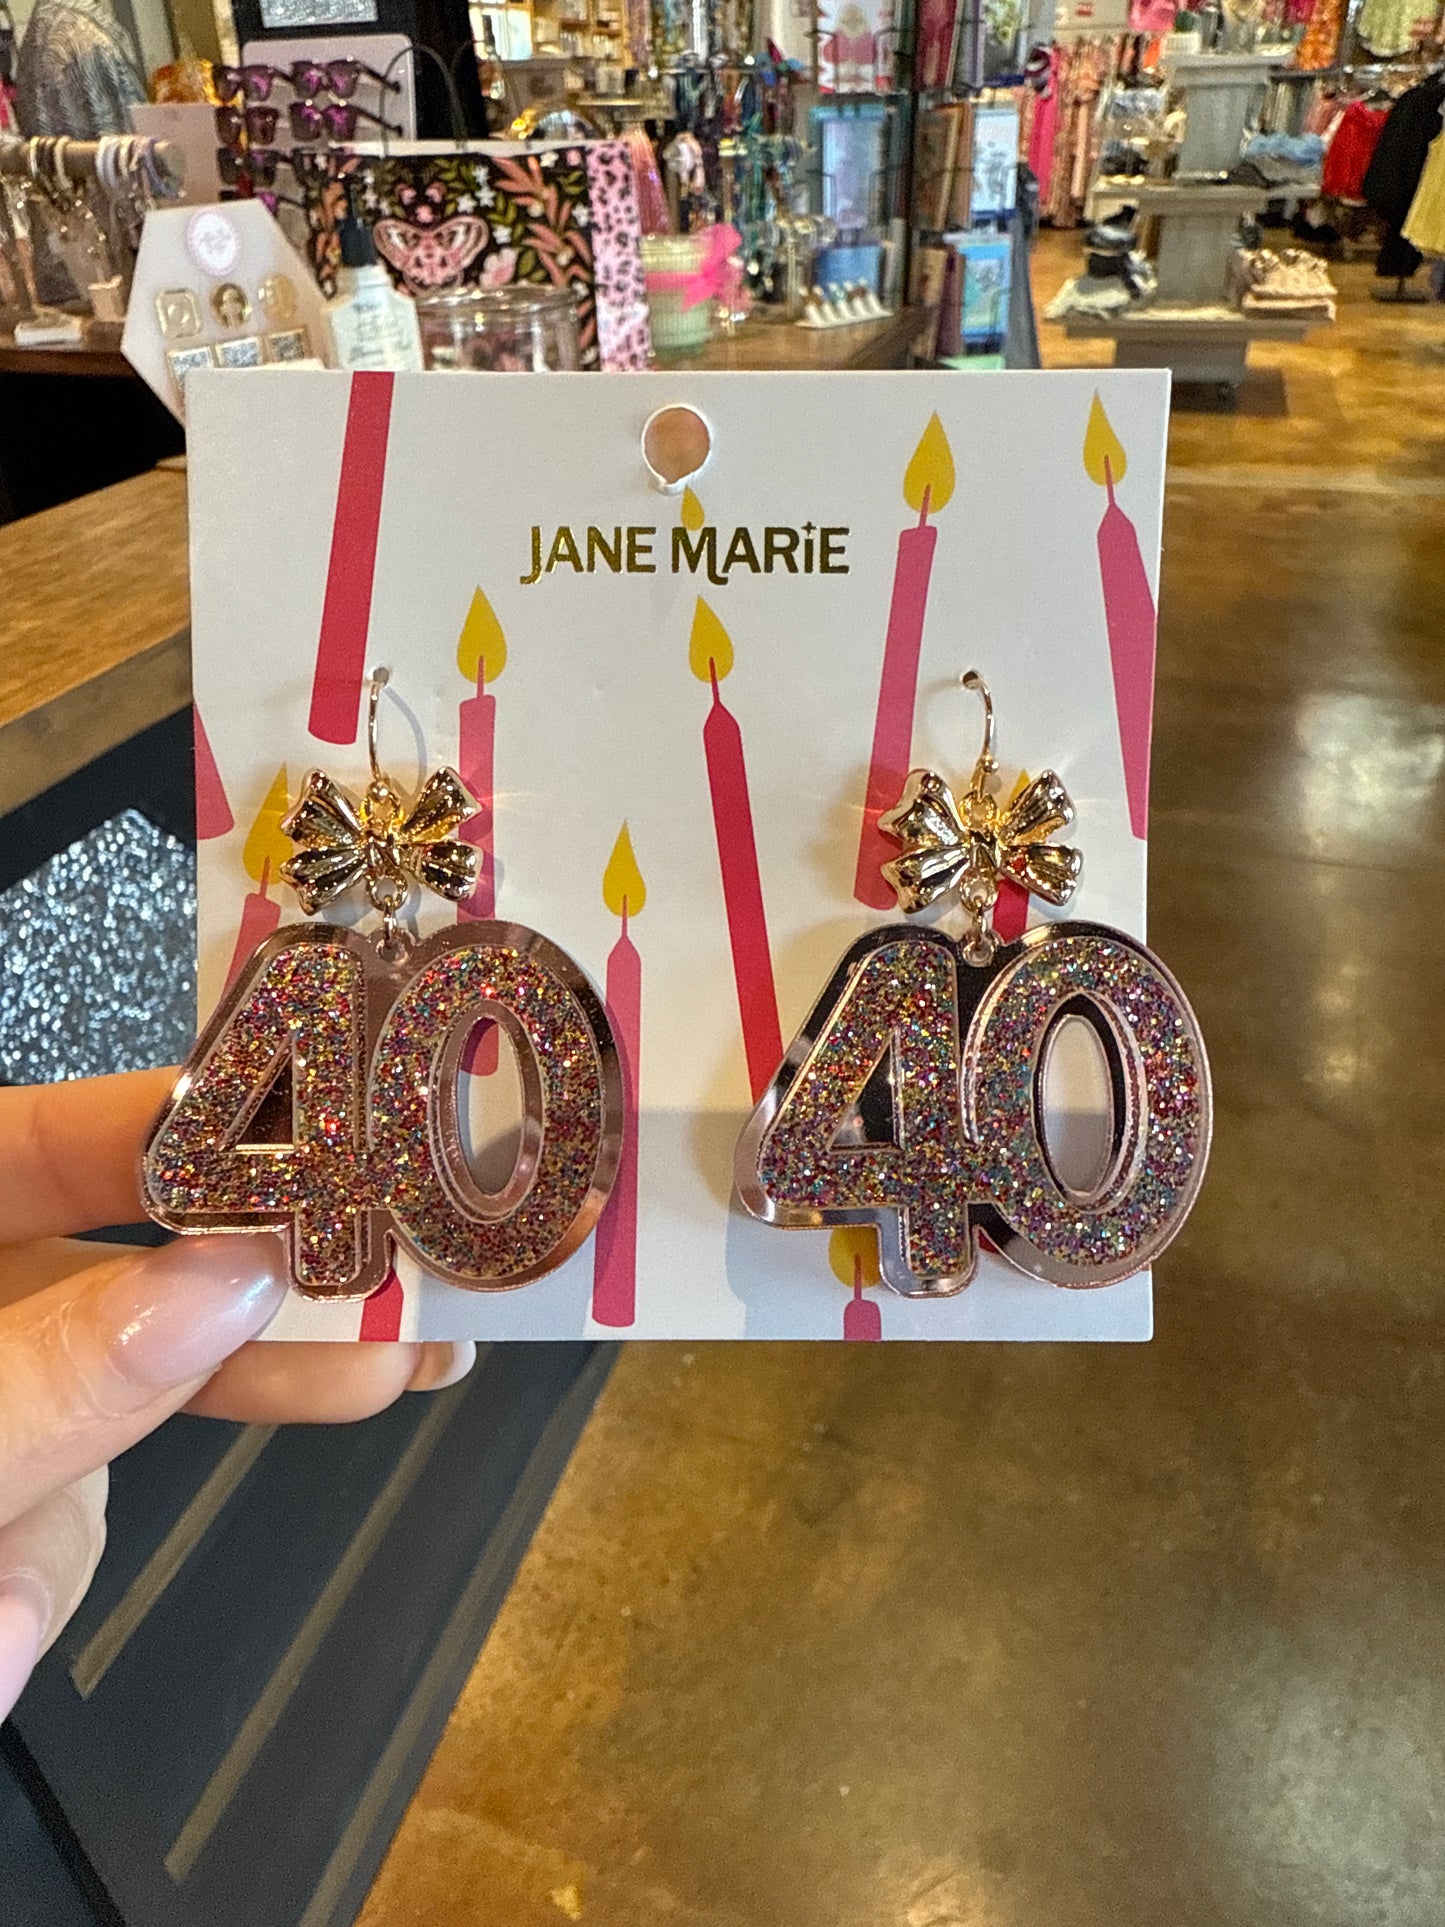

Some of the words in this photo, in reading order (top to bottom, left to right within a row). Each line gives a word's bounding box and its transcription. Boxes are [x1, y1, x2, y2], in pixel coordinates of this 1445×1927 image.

[519, 525, 657, 586] JANE
[143, 940, 607, 1288] 40
[750, 937, 1203, 1280] 40
